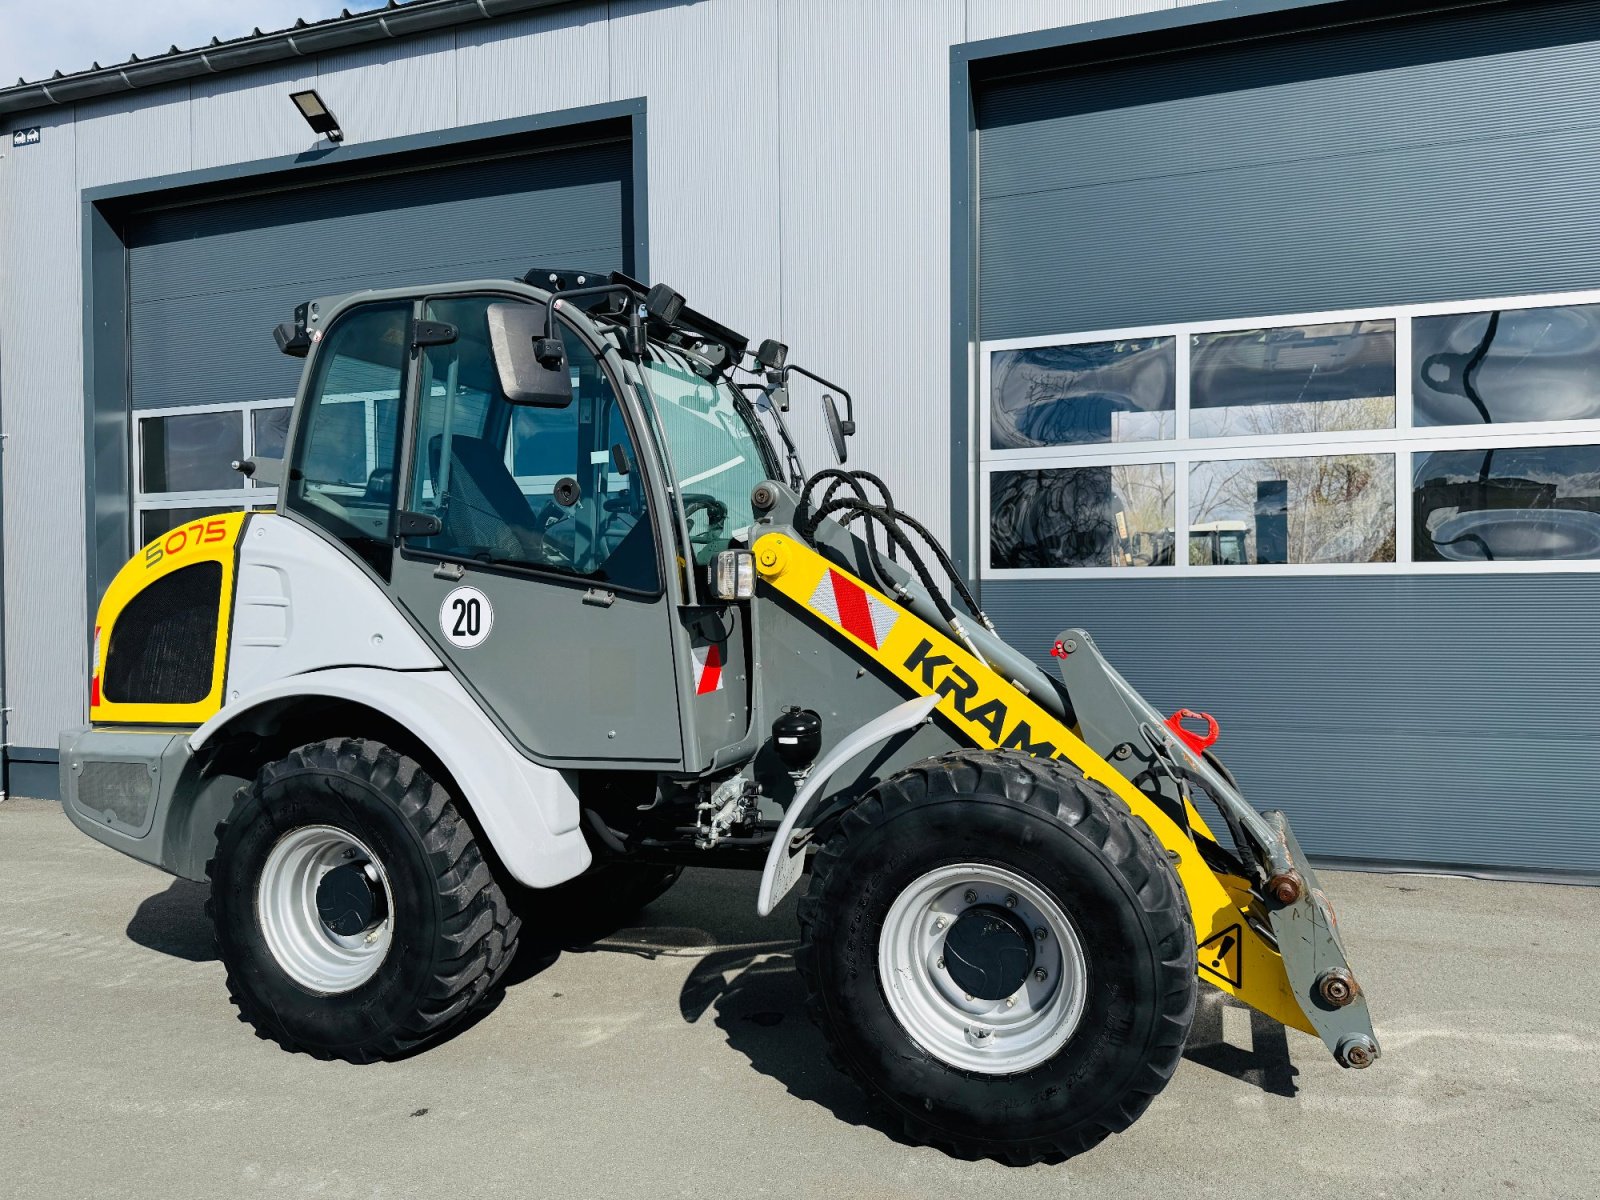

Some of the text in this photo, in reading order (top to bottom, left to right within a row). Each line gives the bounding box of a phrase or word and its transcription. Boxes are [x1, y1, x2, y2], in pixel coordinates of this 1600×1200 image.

[145, 520, 226, 569] 5075
[452, 598, 481, 636] 20
[903, 638, 1108, 789] KRAM
